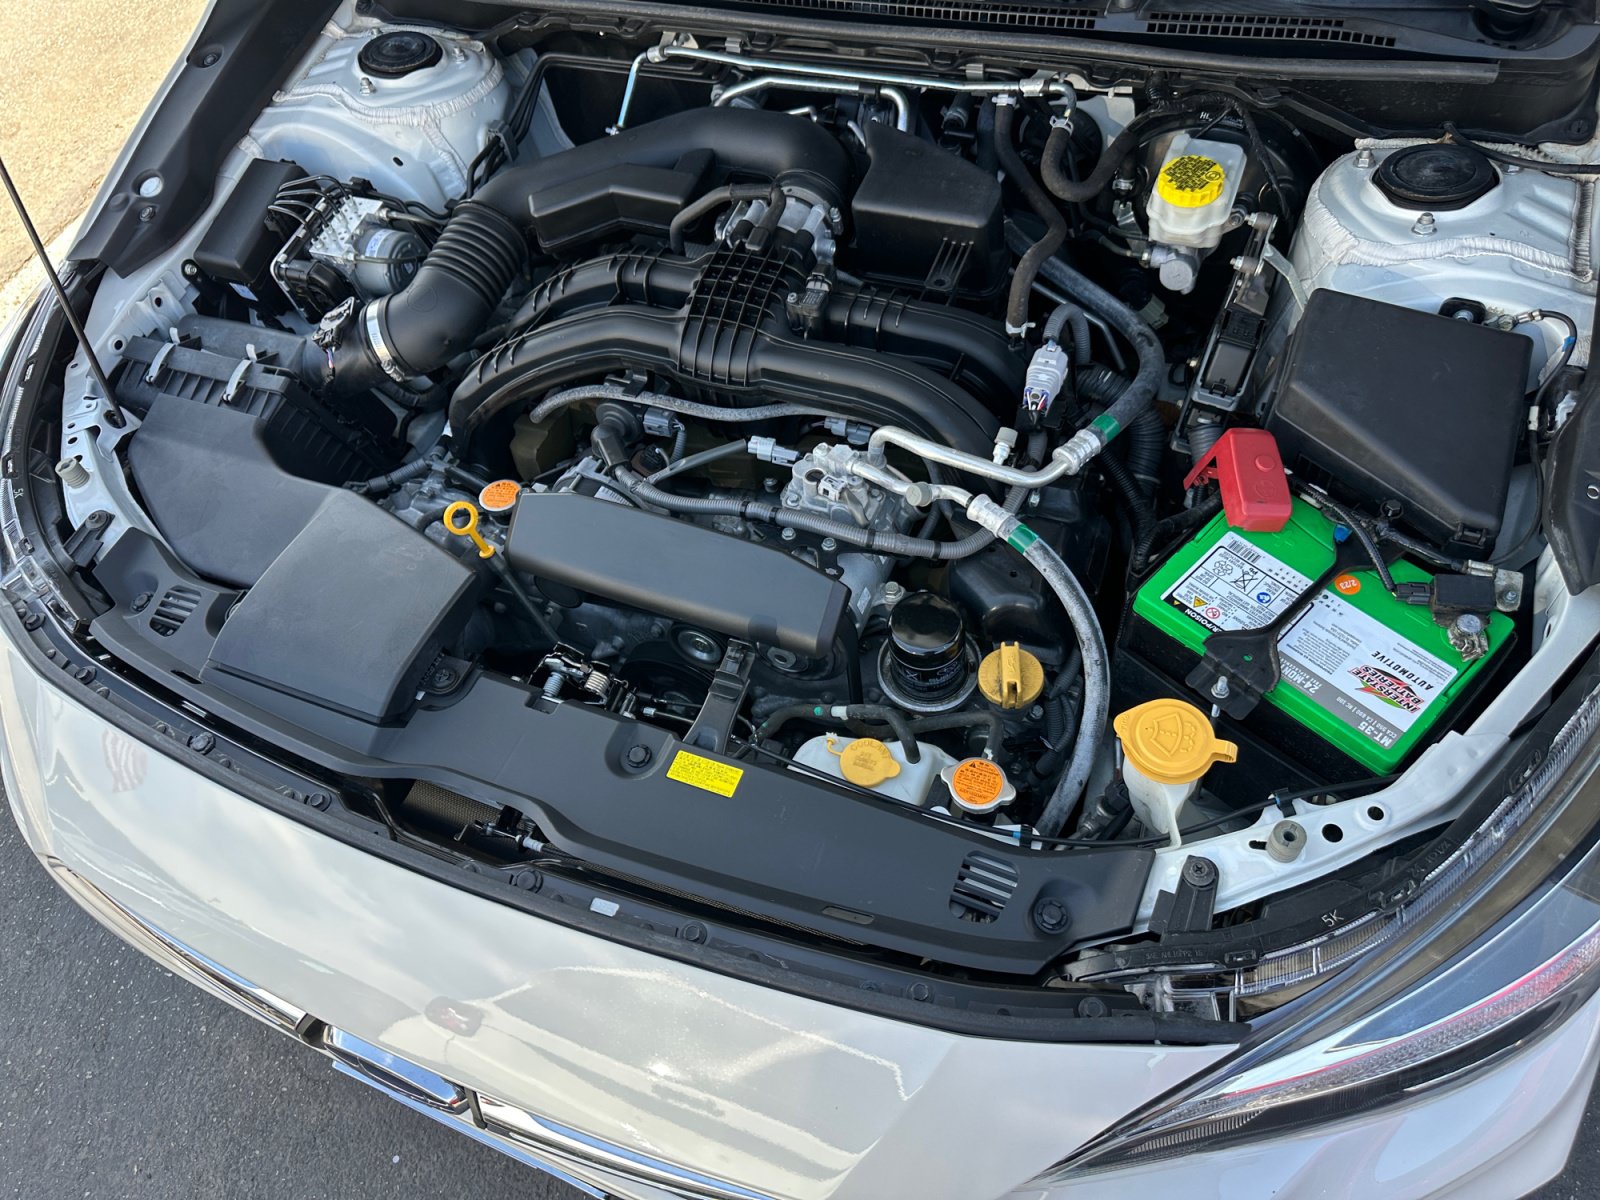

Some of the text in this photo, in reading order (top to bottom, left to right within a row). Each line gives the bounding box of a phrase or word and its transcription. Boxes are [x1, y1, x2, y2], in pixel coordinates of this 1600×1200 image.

[1280, 663, 1319, 693] 24-MONT
[1362, 665, 1420, 704] BATTERIES
[1371, 650, 1433, 690] AUTOMOTIVE
[1351, 669, 1417, 712] INTERSTATE
[1357, 720, 1392, 746] MT-35
[1321, 909, 1344, 927] 5K
